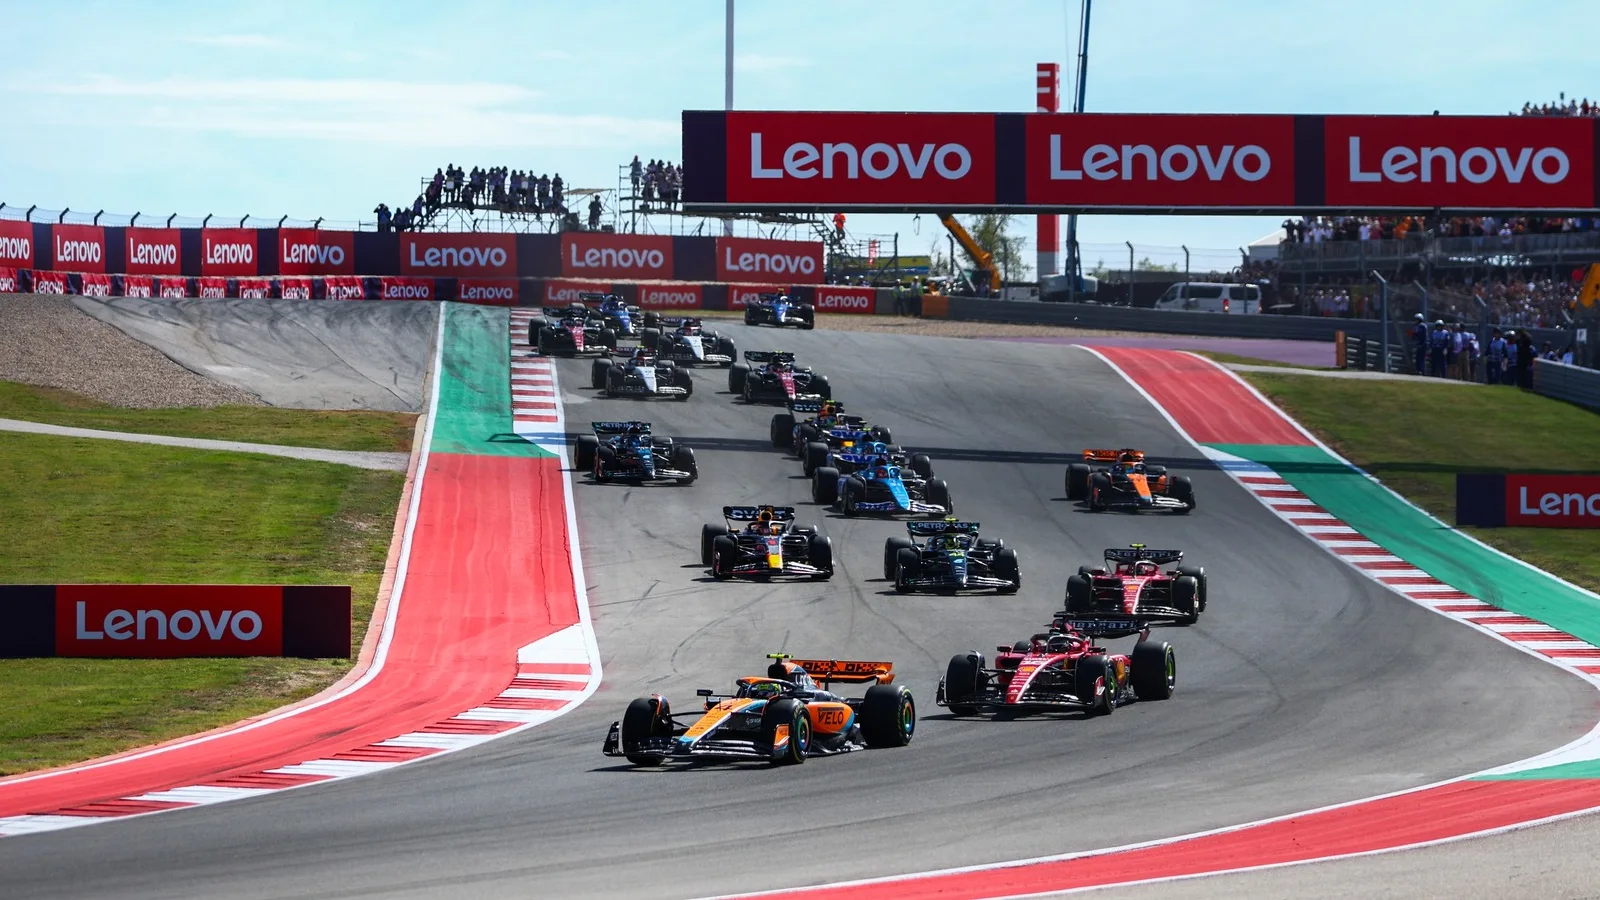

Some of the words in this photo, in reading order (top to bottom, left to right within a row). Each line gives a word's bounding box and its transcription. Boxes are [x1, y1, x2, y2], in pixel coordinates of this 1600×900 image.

[750, 132, 972, 180] Lenovo
[1050, 134, 1271, 181] Lenovo
[1349, 136, 1570, 184] Lenovo
[0, 236, 30, 260] novo
[56, 235, 101, 263] Lenovo
[130, 237, 177, 265] Lenovo
[206, 239, 253, 264] Lenovo
[283, 238, 345, 265] Lenovo
[410, 243, 507, 267] Lenovo
[572, 244, 664, 269] Lenovo
[726, 247, 816, 274] Lenovo
[33, 277, 64, 294] Lenovo
[82, 280, 110, 296] Lenovo
[281, 284, 310, 300] Lenovo
[384, 282, 430, 298] Lenovo
[461, 284, 514, 299] Lenovo
[642, 287, 697, 304] Lenovo
[732, 289, 760, 305] Len
[818, 291, 869, 308] Lenovo
[1519, 486, 1600, 516] Leno
[76, 600, 263, 641] Lenovo
[817, 711, 844, 725] VELO
